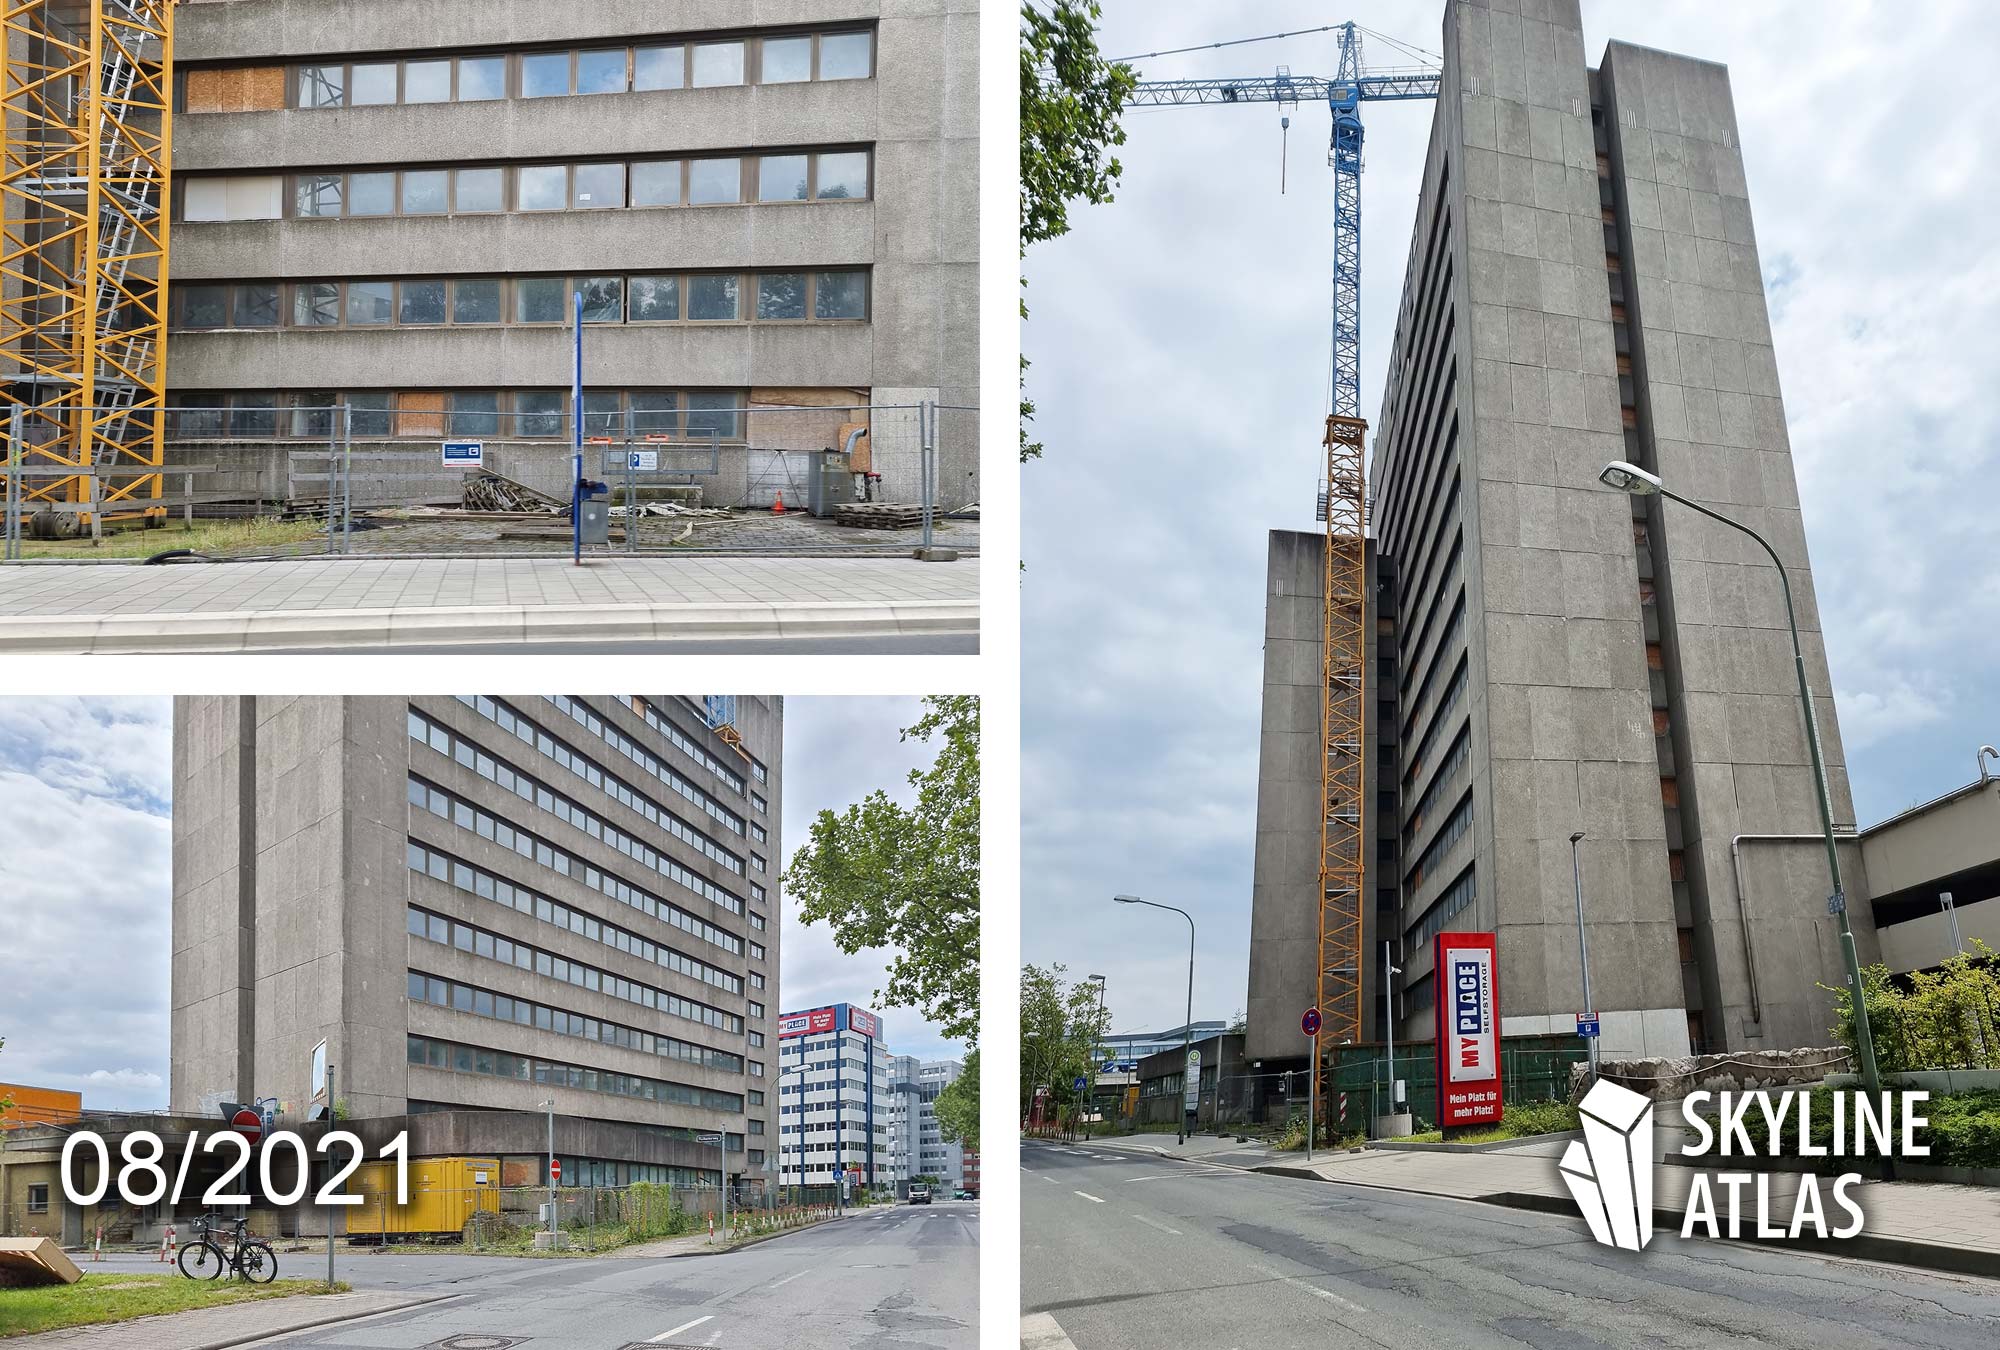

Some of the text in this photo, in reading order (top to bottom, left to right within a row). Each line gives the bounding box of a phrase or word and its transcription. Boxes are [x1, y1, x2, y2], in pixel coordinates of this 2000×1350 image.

[1459, 966, 1479, 1067] MY PLACE
[1481, 962, 1489, 1034] SELFSTORAGE
[1450, 1091, 1497, 1104] Mein Platz für
[1454, 1105, 1494, 1118] mehr Platz!
